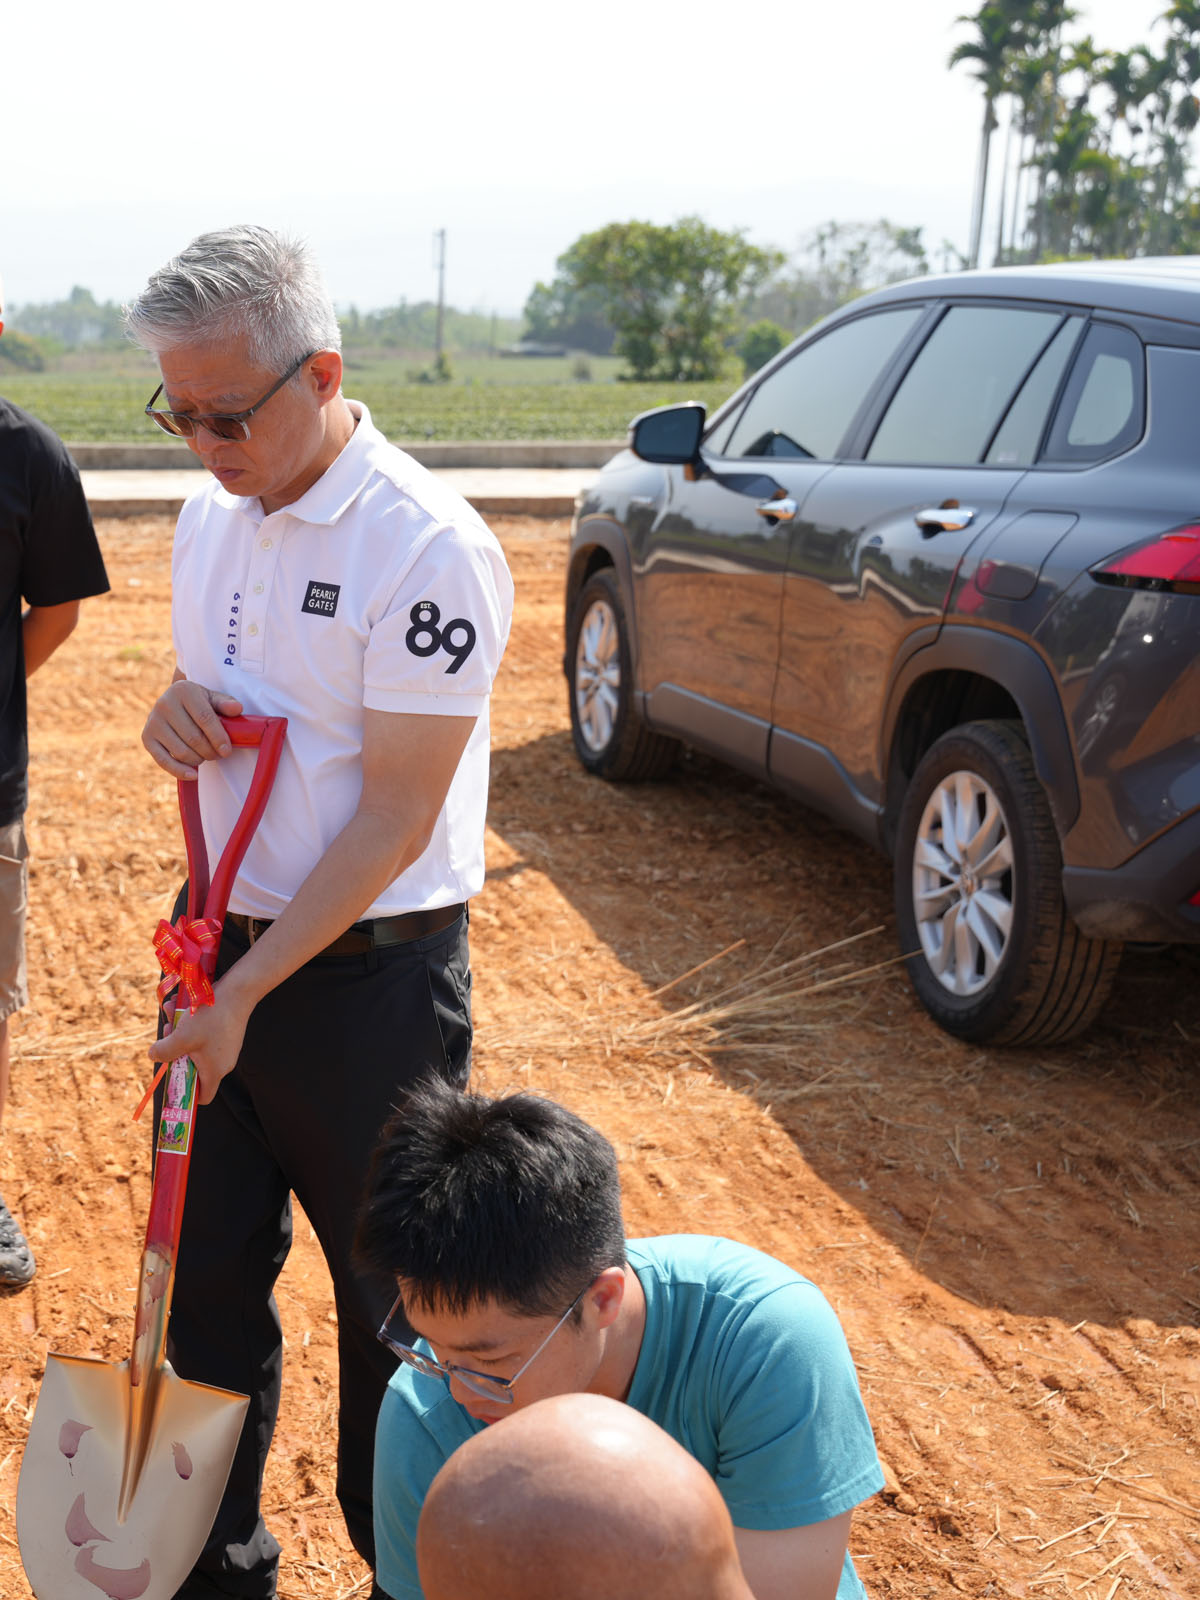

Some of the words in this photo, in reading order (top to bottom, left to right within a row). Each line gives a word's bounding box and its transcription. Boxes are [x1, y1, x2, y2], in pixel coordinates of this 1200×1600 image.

[311, 586, 337, 600] PEARLY
[308, 599, 335, 611] GATES
[406, 601, 476, 674] 89
